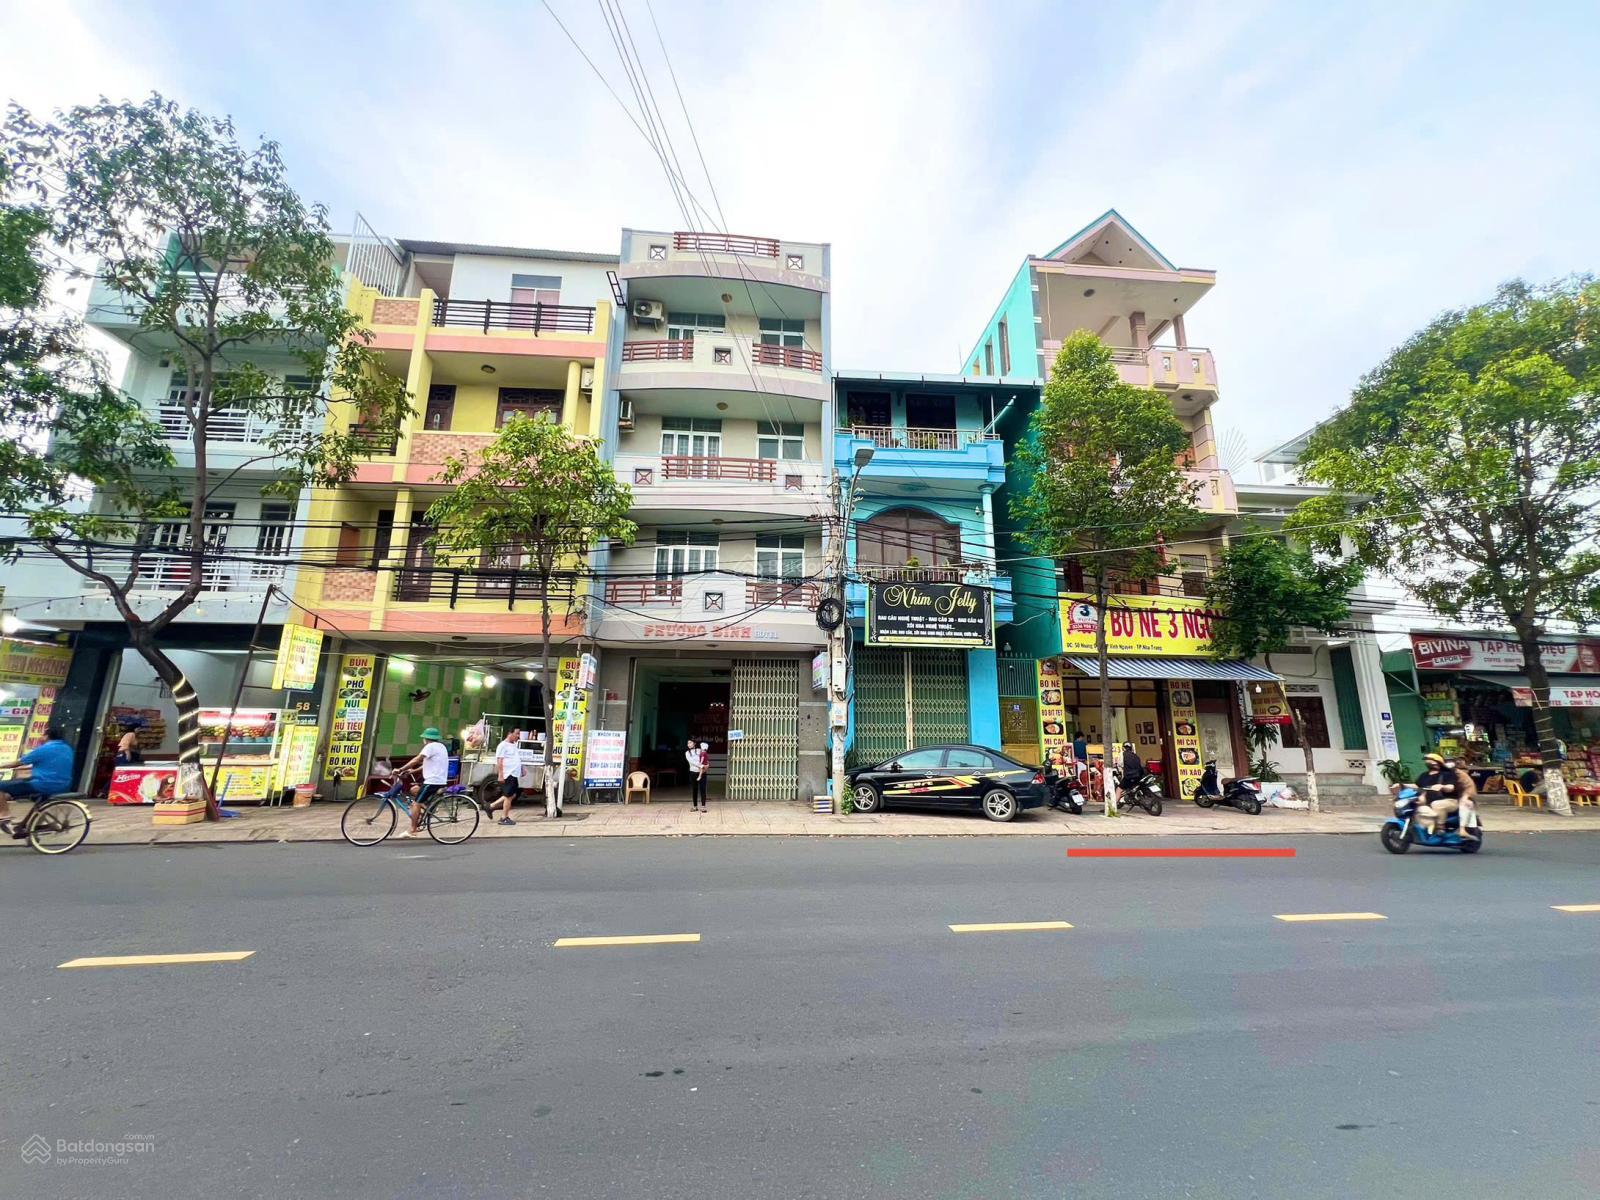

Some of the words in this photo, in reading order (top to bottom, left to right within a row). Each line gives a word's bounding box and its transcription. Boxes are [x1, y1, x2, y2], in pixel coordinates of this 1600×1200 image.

[883, 585, 932, 609] Nhím
[935, 586, 977, 615] Jelly
[1111, 600, 1134, 637] BÒ
[1140, 600, 1162, 638] NÉ
[1168, 608, 1178, 638] 3
[1182, 608, 1222, 640] NGO
[1418, 639, 1469, 656] BIVINA
[296, 702, 311, 711] 58
[342, 757, 357, 766] KHO
